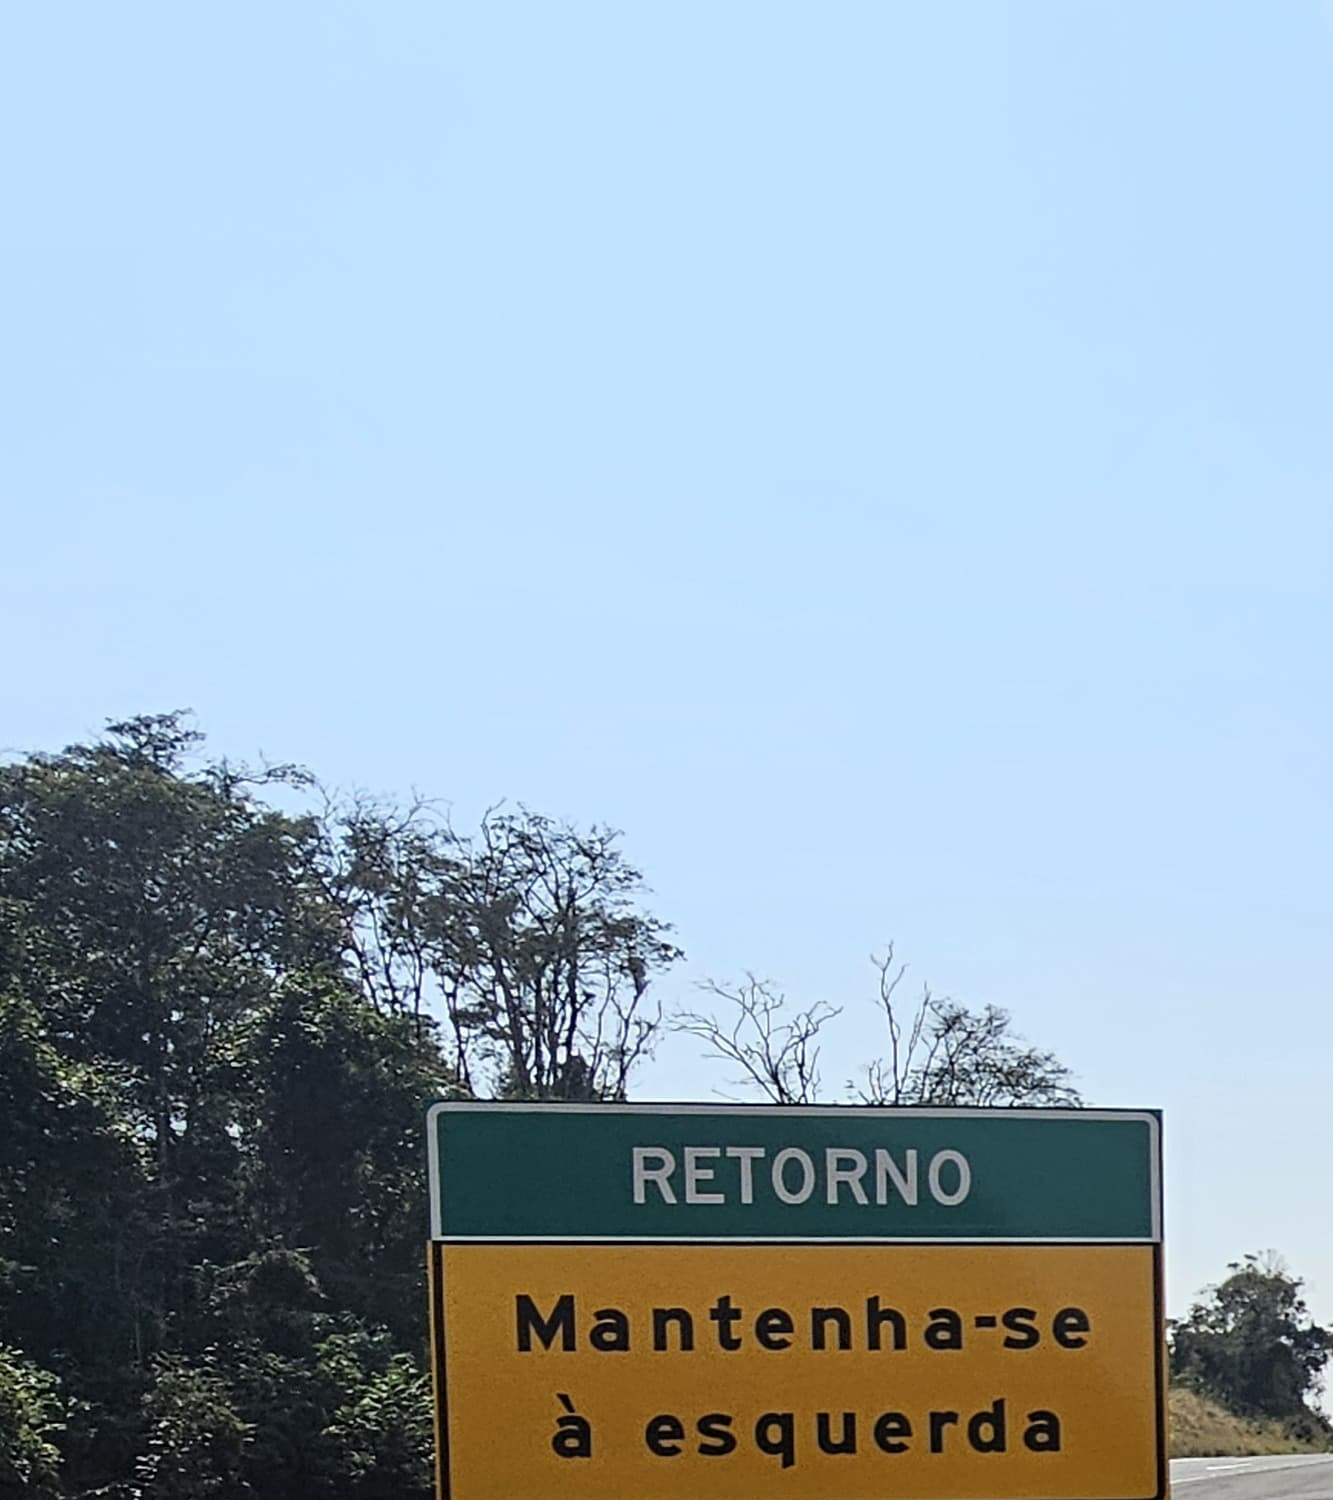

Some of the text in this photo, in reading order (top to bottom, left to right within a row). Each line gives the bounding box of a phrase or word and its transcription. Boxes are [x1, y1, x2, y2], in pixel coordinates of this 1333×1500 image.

[632, 1146, 972, 1206] RETORNO
[515, 1293, 1091, 1353] Mantenha-se
[550, 1392, 1062, 1470] à esquerda
